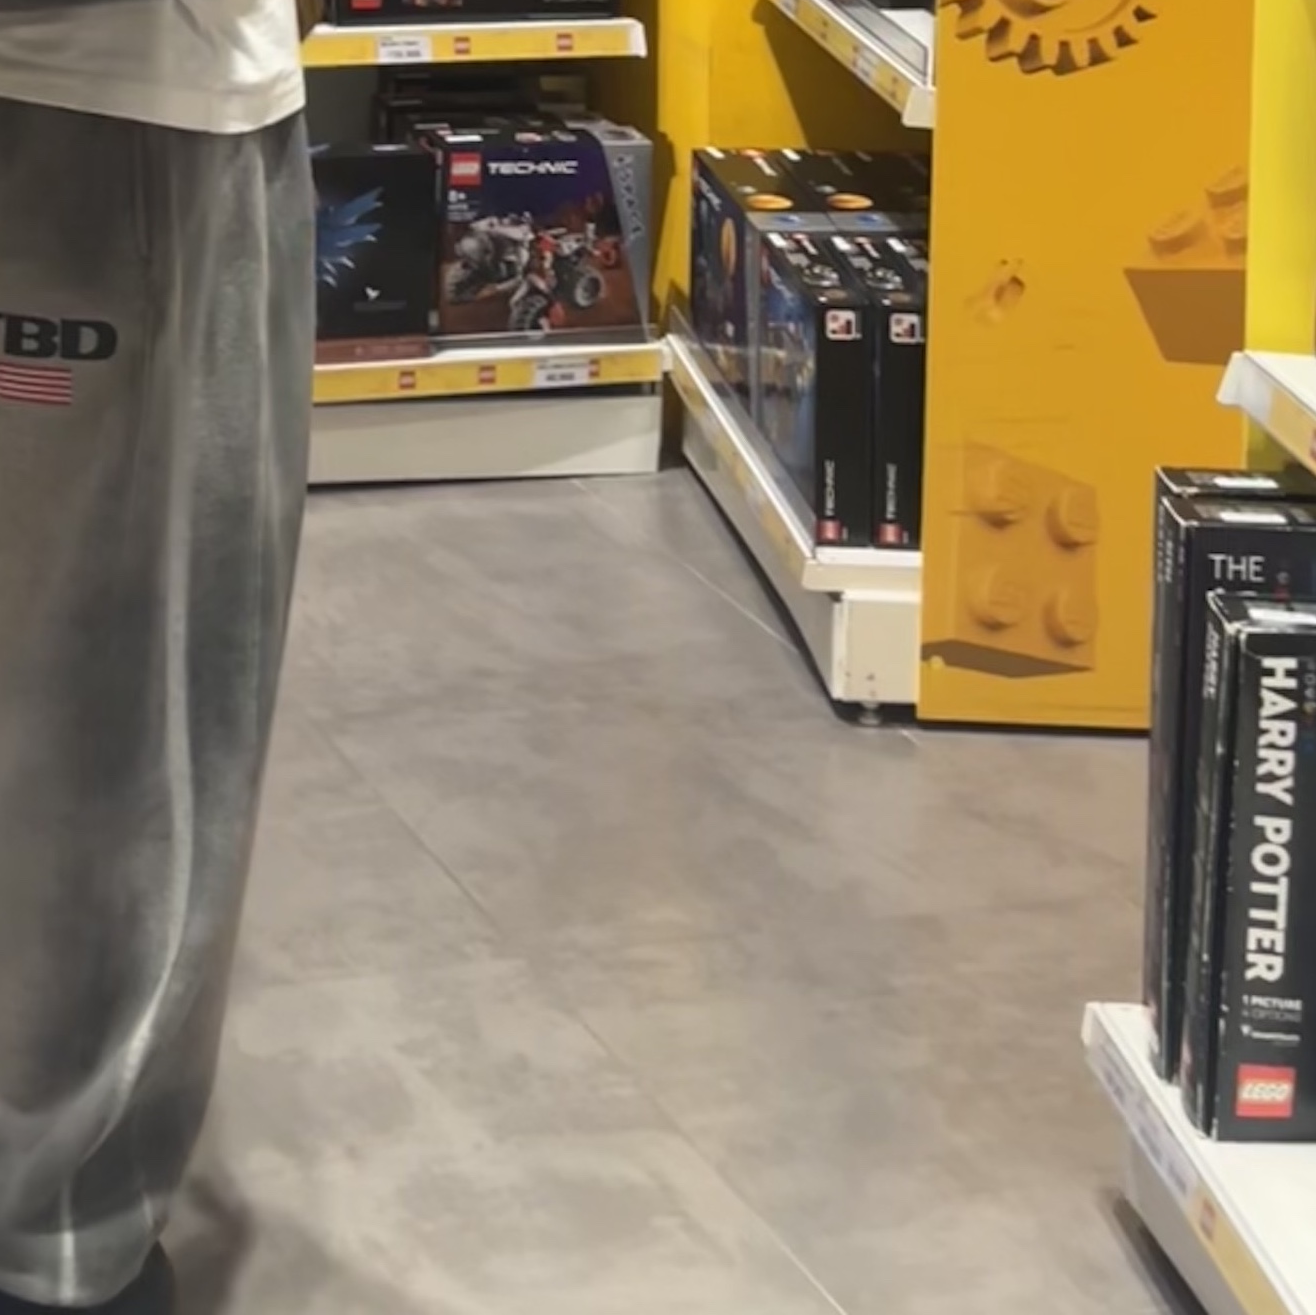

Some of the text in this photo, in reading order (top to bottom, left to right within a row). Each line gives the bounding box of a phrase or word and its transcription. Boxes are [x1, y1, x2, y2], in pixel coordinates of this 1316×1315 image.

[487, 160, 579, 175] TECHNIC
[1207, 552, 1266, 583] THE
[1244, 656, 1299, 983] HARRY POTTER
